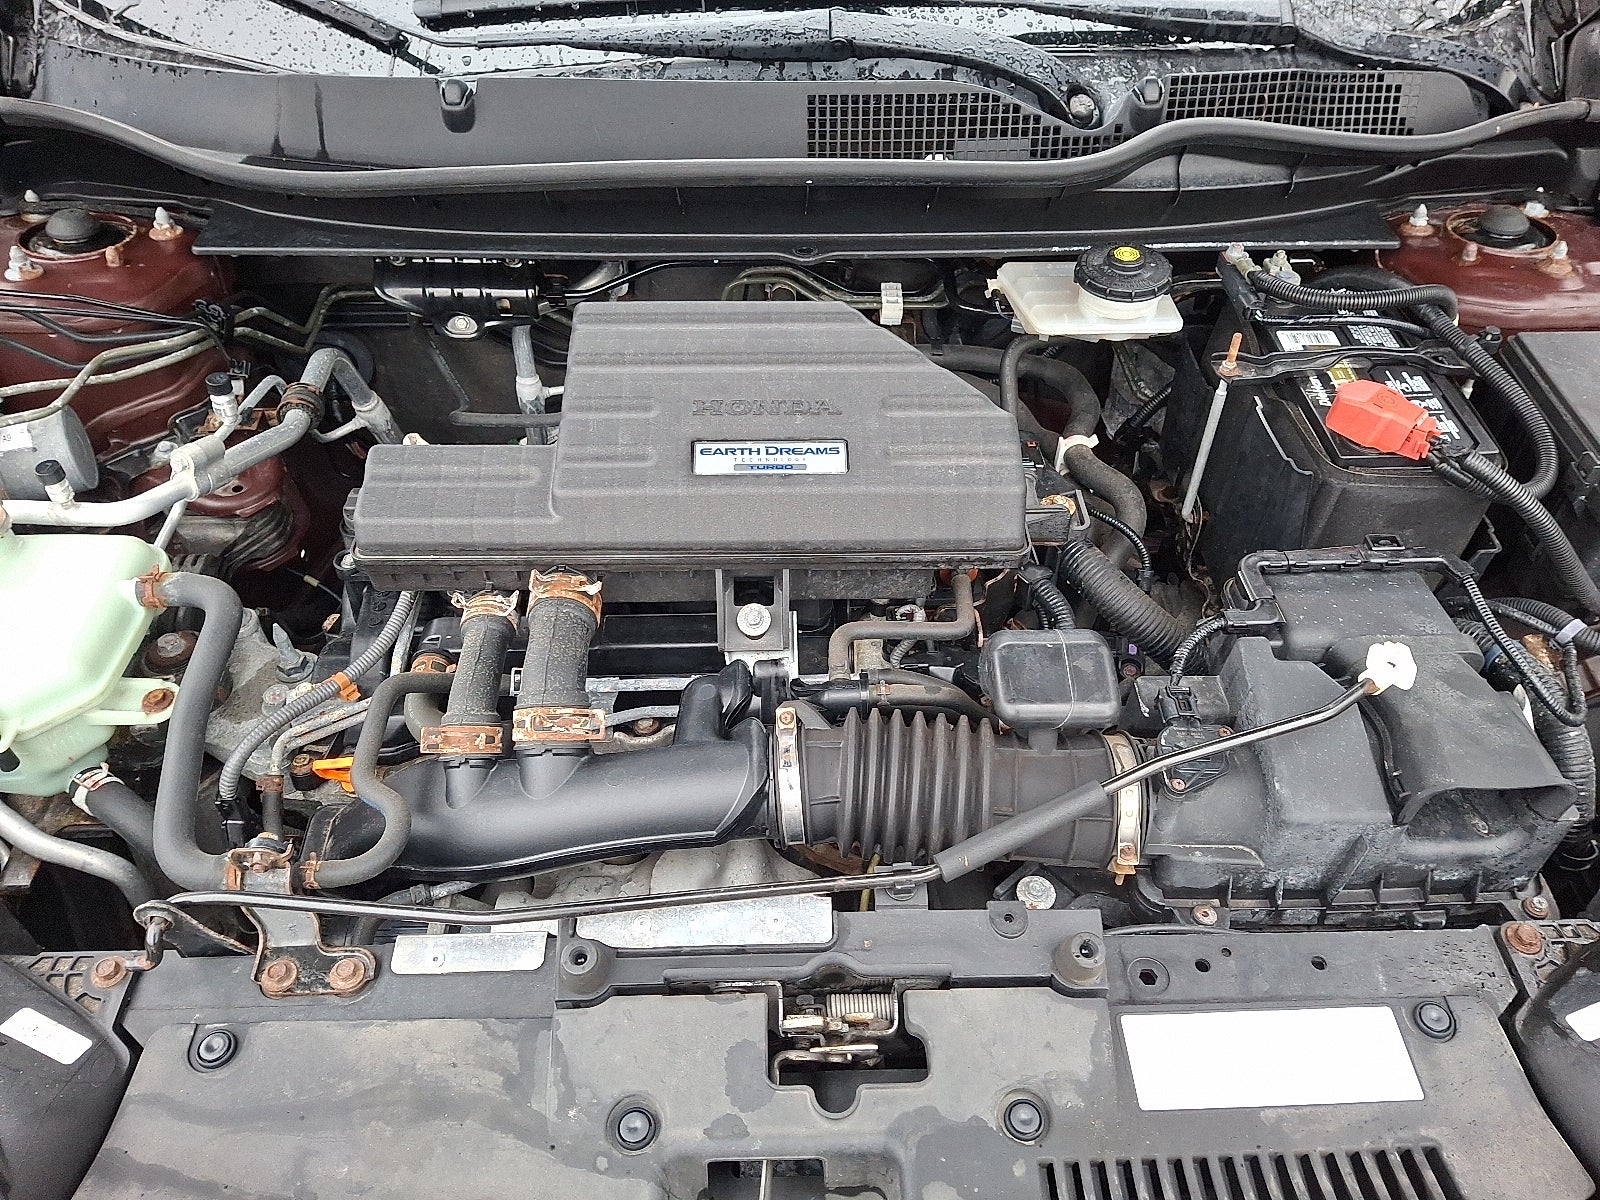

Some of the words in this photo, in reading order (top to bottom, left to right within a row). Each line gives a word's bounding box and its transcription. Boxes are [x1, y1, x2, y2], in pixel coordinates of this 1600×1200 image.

[692, 399, 843, 416] HONDA
[699, 447, 761, 456] EARTH
[765, 446, 840, 456] DREAMS
